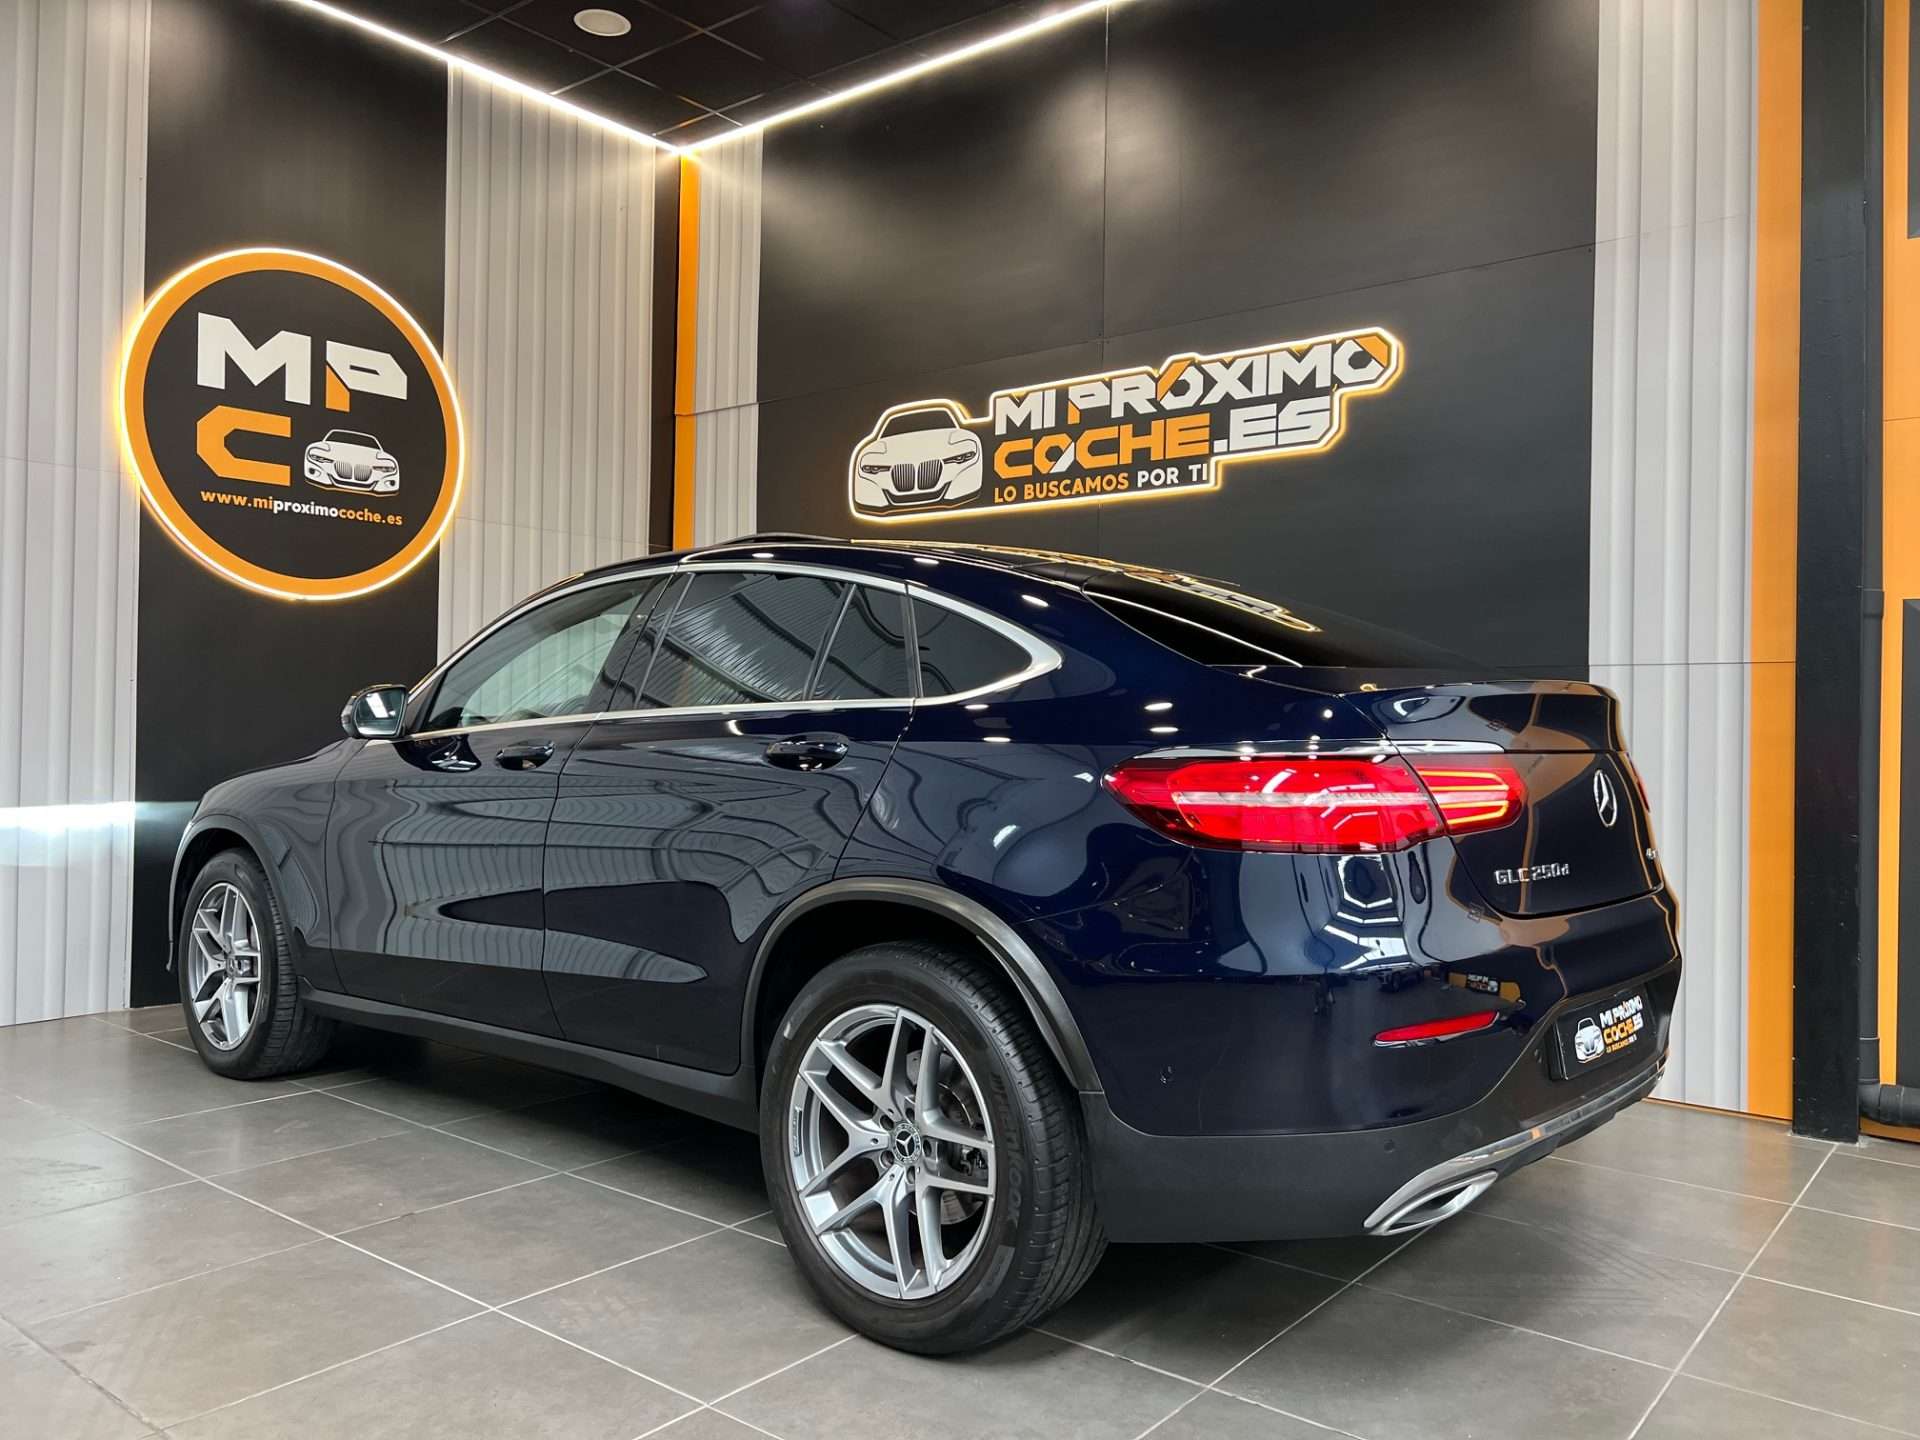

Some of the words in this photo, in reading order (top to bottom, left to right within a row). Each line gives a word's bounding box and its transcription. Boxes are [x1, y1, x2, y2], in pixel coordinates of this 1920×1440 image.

[995, 389, 1056, 436] MI
[196, 405, 291, 487] C
[994, 485, 1017, 504] LO
[1023, 472, 1129, 500] BUSCAMOS
[1137, 469, 1180, 488] POR
[1188, 463, 1208, 482] TI
[200, 489, 403, 526] www.miproximocoche.es
